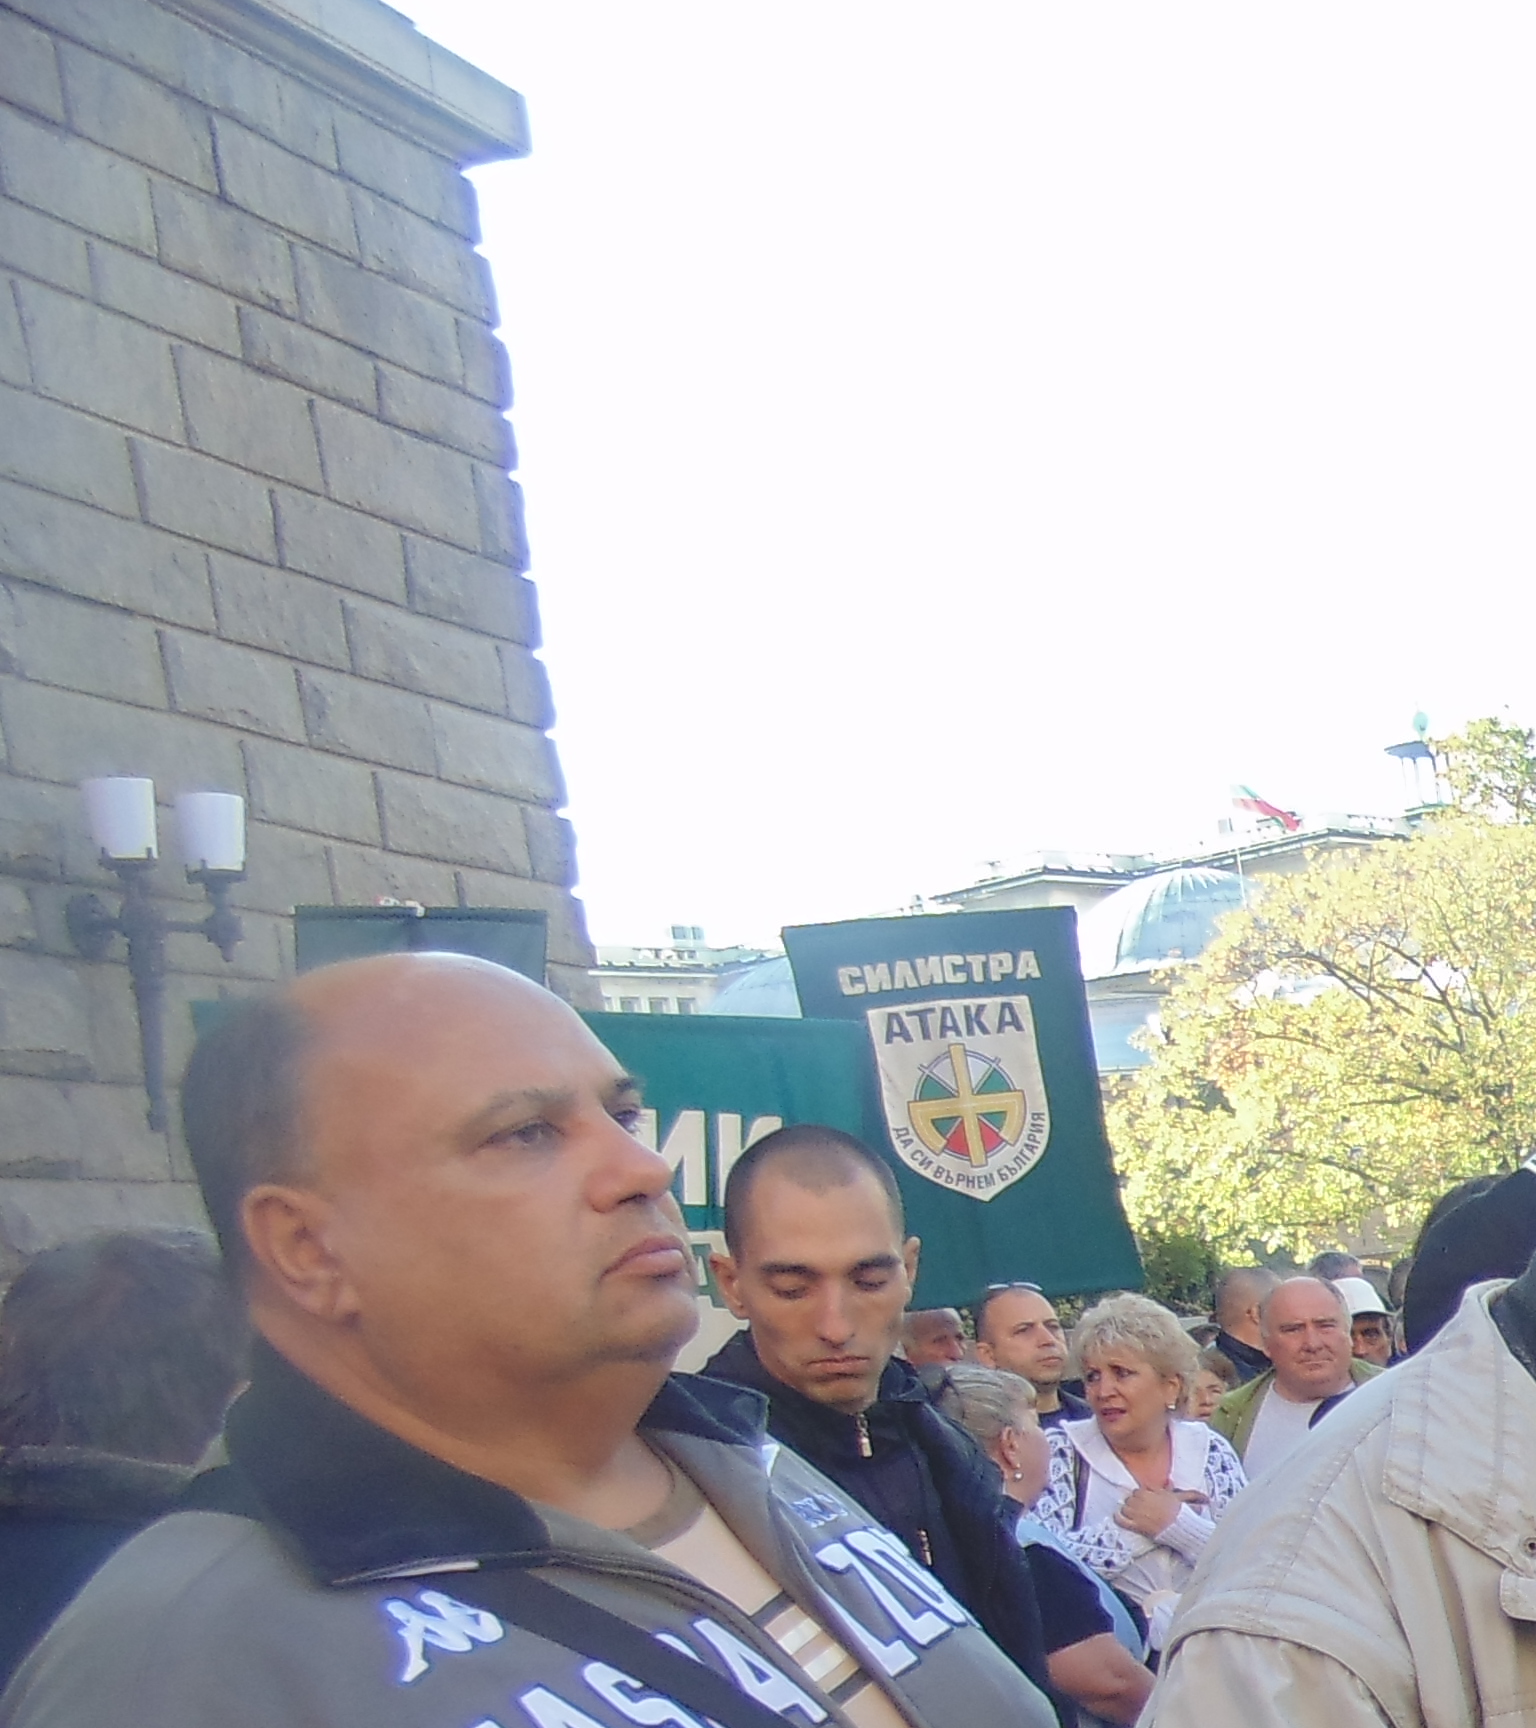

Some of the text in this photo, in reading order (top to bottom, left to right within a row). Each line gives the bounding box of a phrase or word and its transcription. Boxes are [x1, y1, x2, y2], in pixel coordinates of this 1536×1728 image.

[837, 950, 1041, 997] СИЛИСТРА
[883, 1001, 1026, 1046] АТАКА
[892, 1111, 1046, 1190] ДА СИ ВЪРНЕМ БЪЛГАРИЯ
